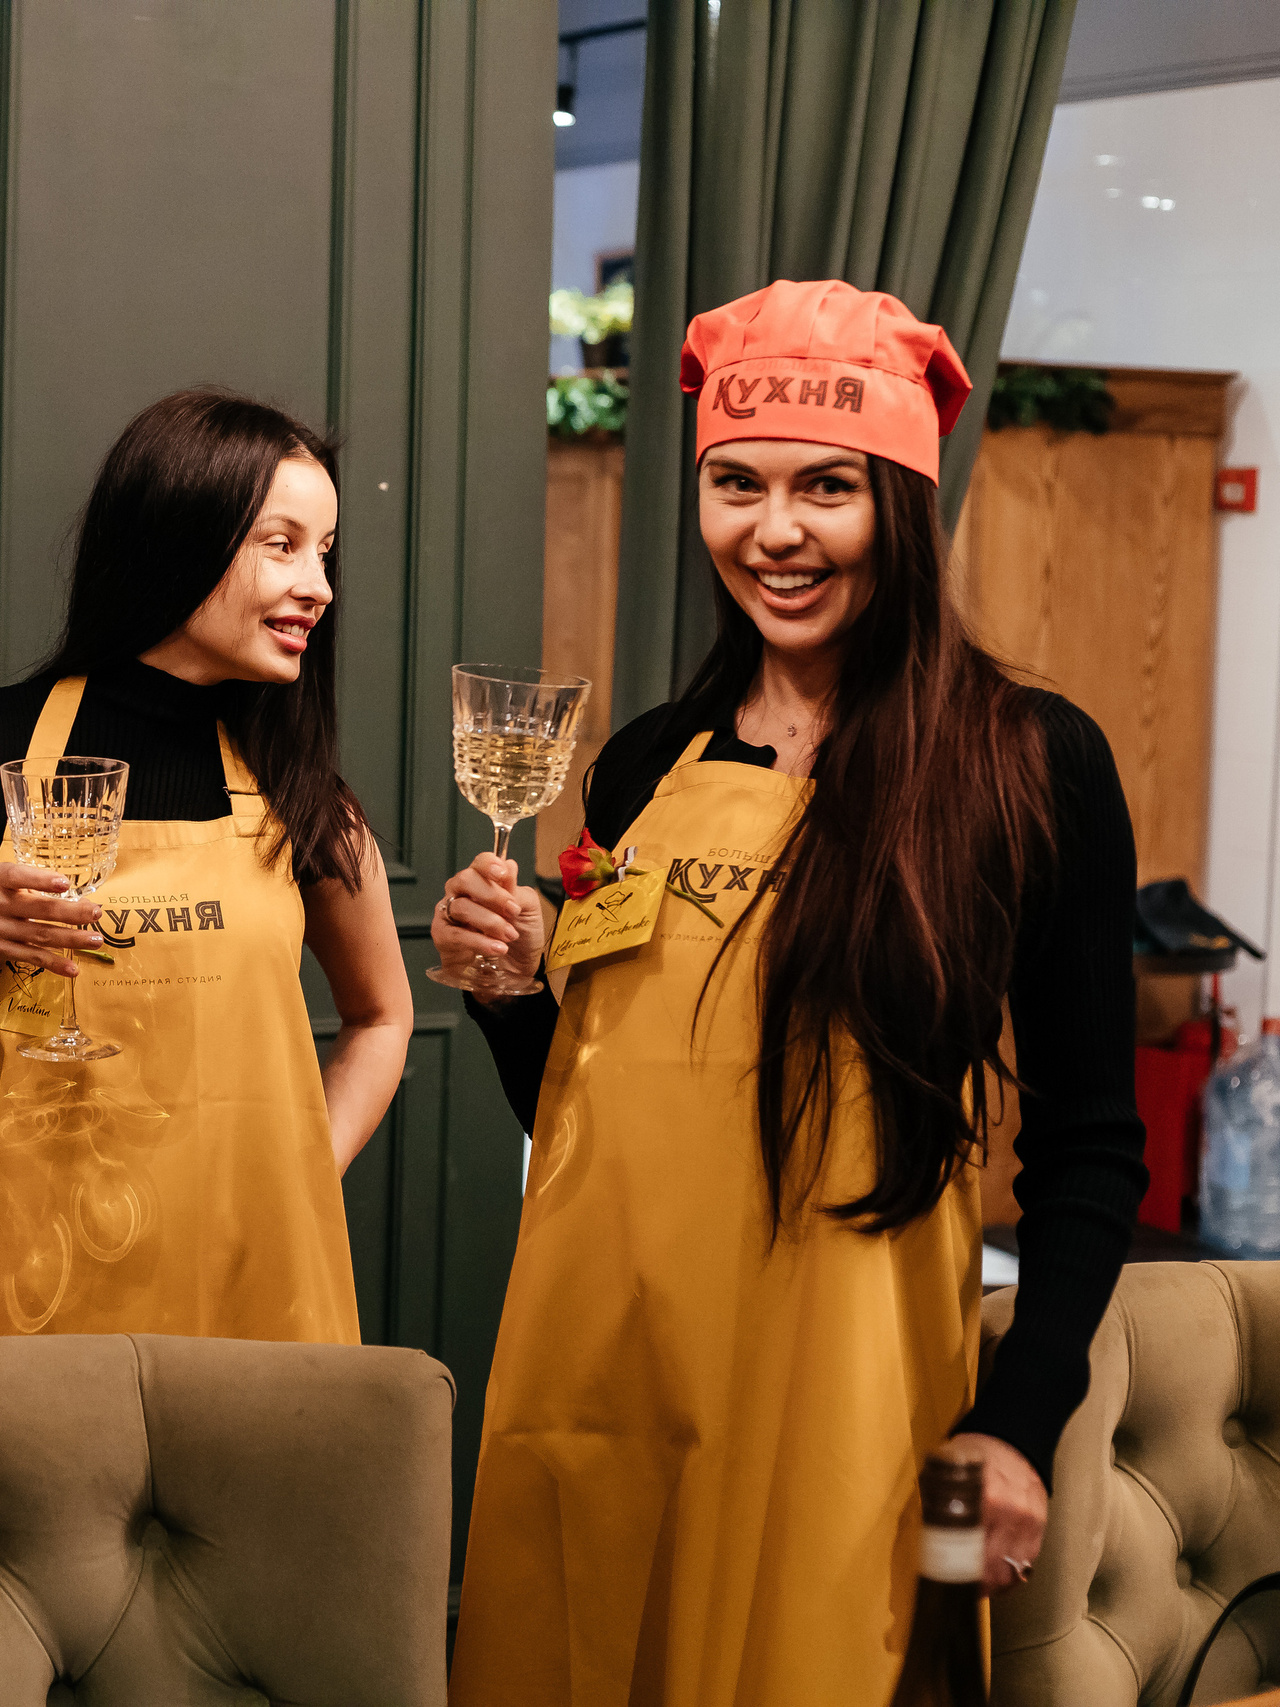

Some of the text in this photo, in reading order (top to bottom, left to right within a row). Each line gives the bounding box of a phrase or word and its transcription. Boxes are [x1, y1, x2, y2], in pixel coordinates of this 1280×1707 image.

[711, 374, 866, 420] КУХНЯ
[706, 846, 775, 865] БОЛЬШ
[666, 857, 788, 904] КУХН
[108, 892, 190, 904] БОЛЬШАЯ
[93, 974, 222, 987] КУЛИНАРНАЯ СТУДИЯ
